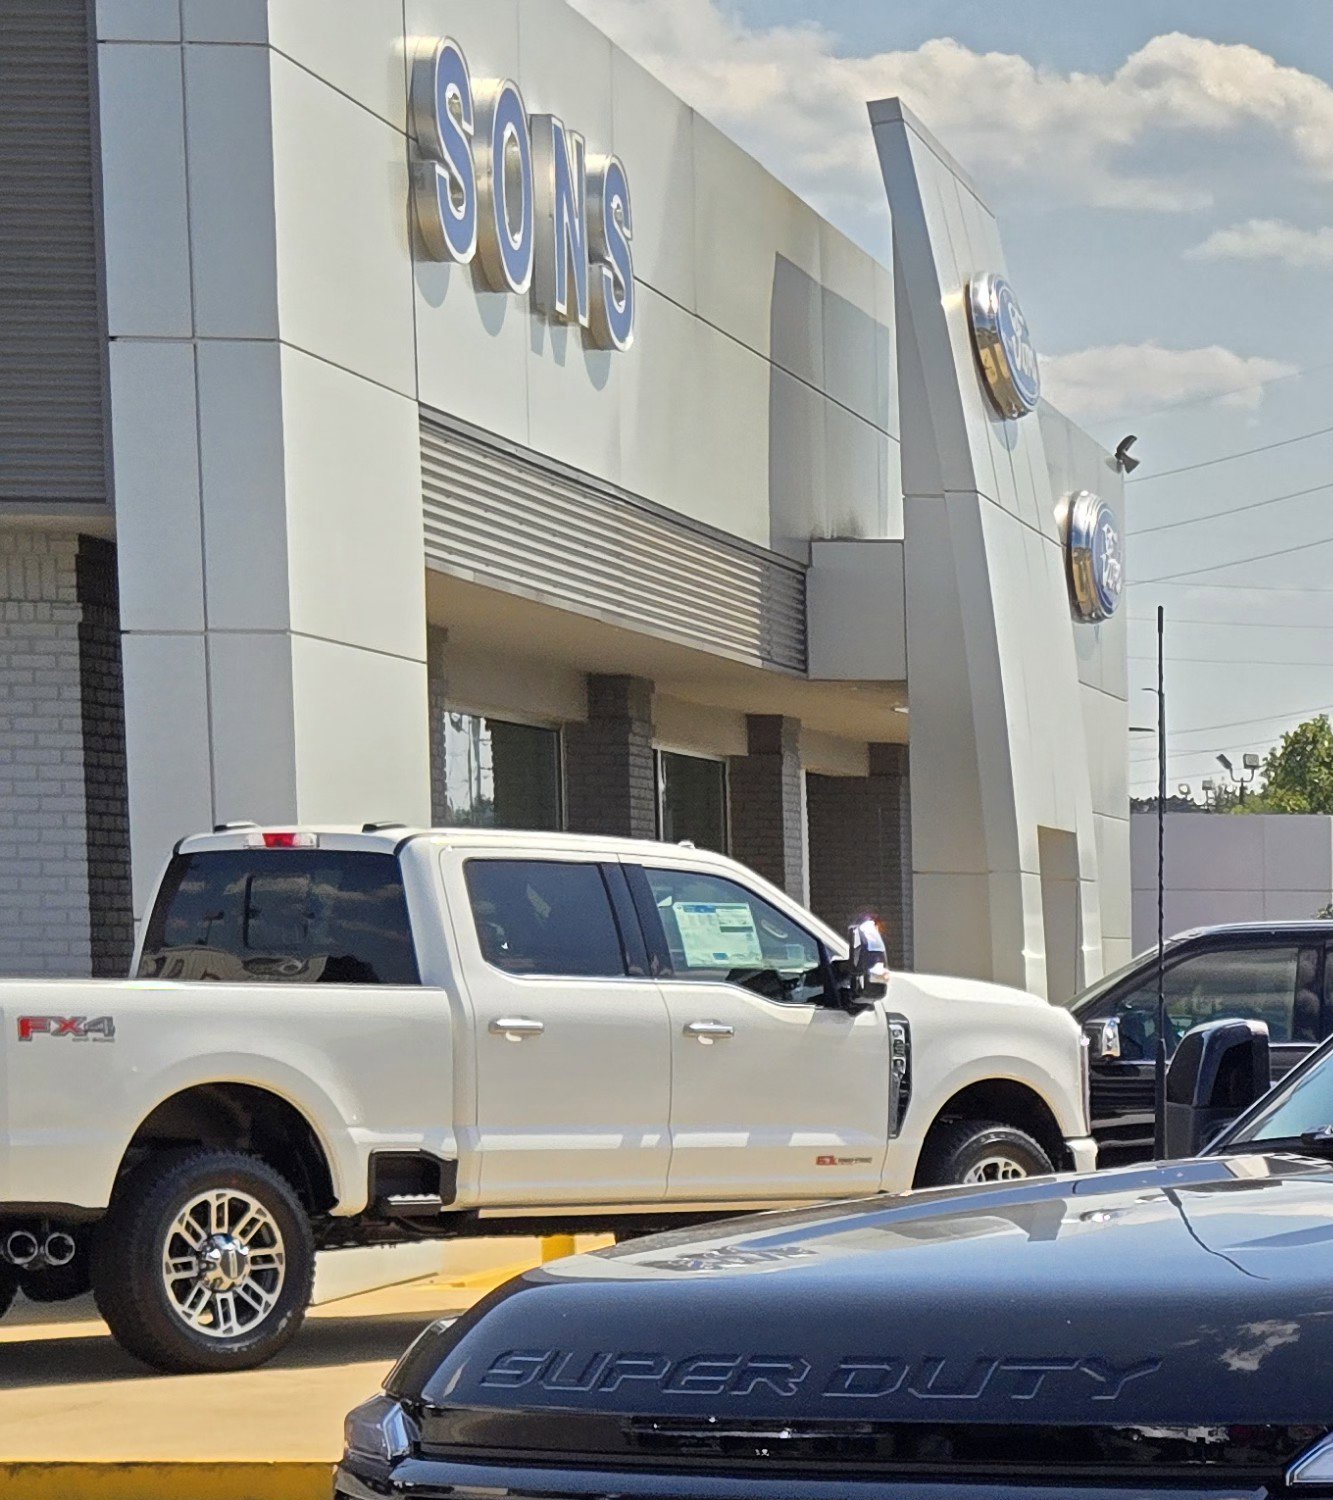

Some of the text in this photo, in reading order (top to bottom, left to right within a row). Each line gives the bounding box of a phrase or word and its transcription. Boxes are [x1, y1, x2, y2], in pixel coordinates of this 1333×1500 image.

[408, 35, 637, 352] SONS
[18, 1016, 115, 1042] FX4
[478, 1349, 1165, 1401] SUPER DUTY
